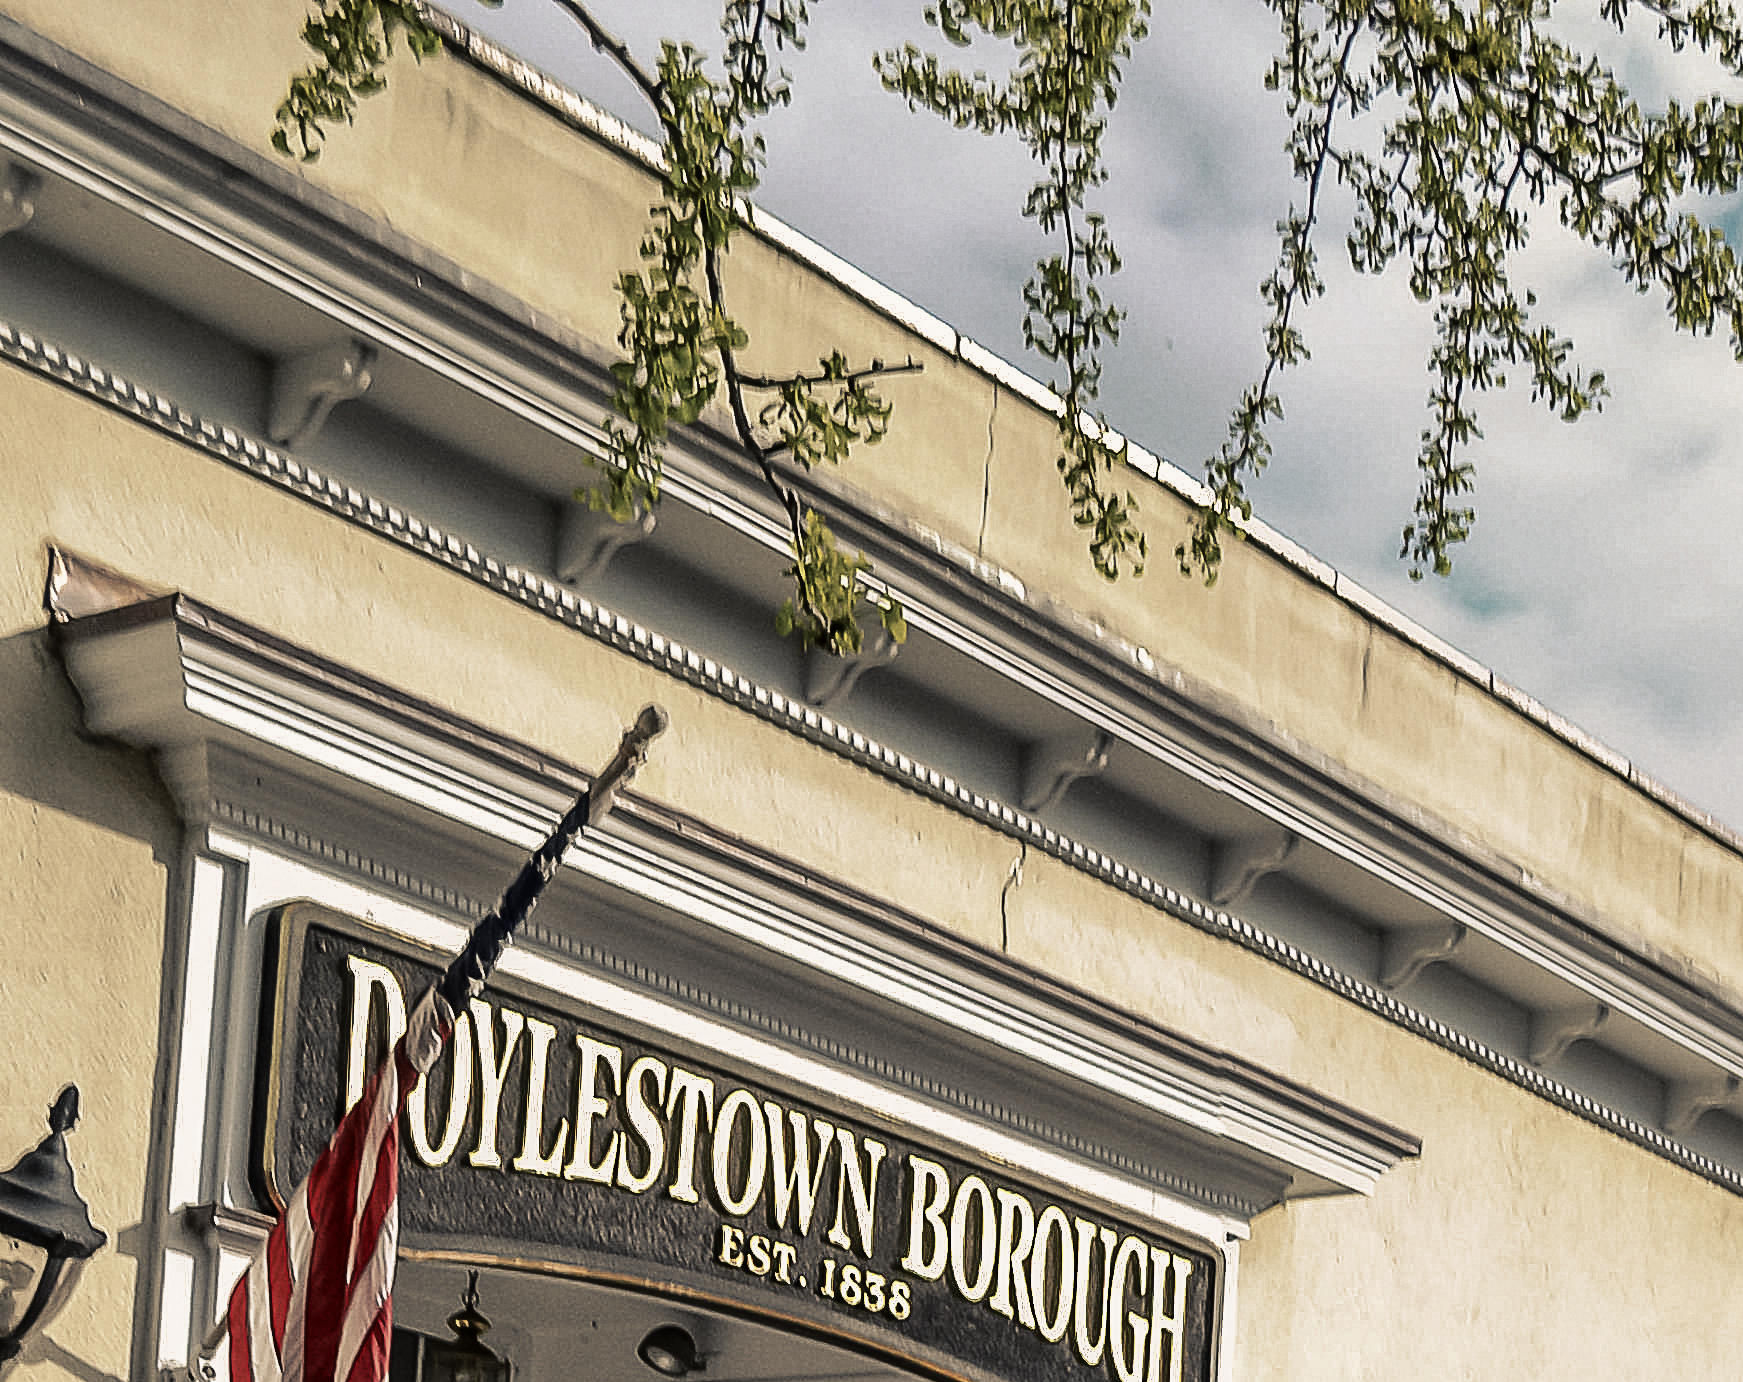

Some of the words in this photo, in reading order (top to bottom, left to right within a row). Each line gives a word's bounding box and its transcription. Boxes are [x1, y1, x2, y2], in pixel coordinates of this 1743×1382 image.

[346, 954, 887, 1260] DOYLESTOWN
[718, 1225, 808, 1288] EST.
[821, 1259, 913, 1322] 1838
